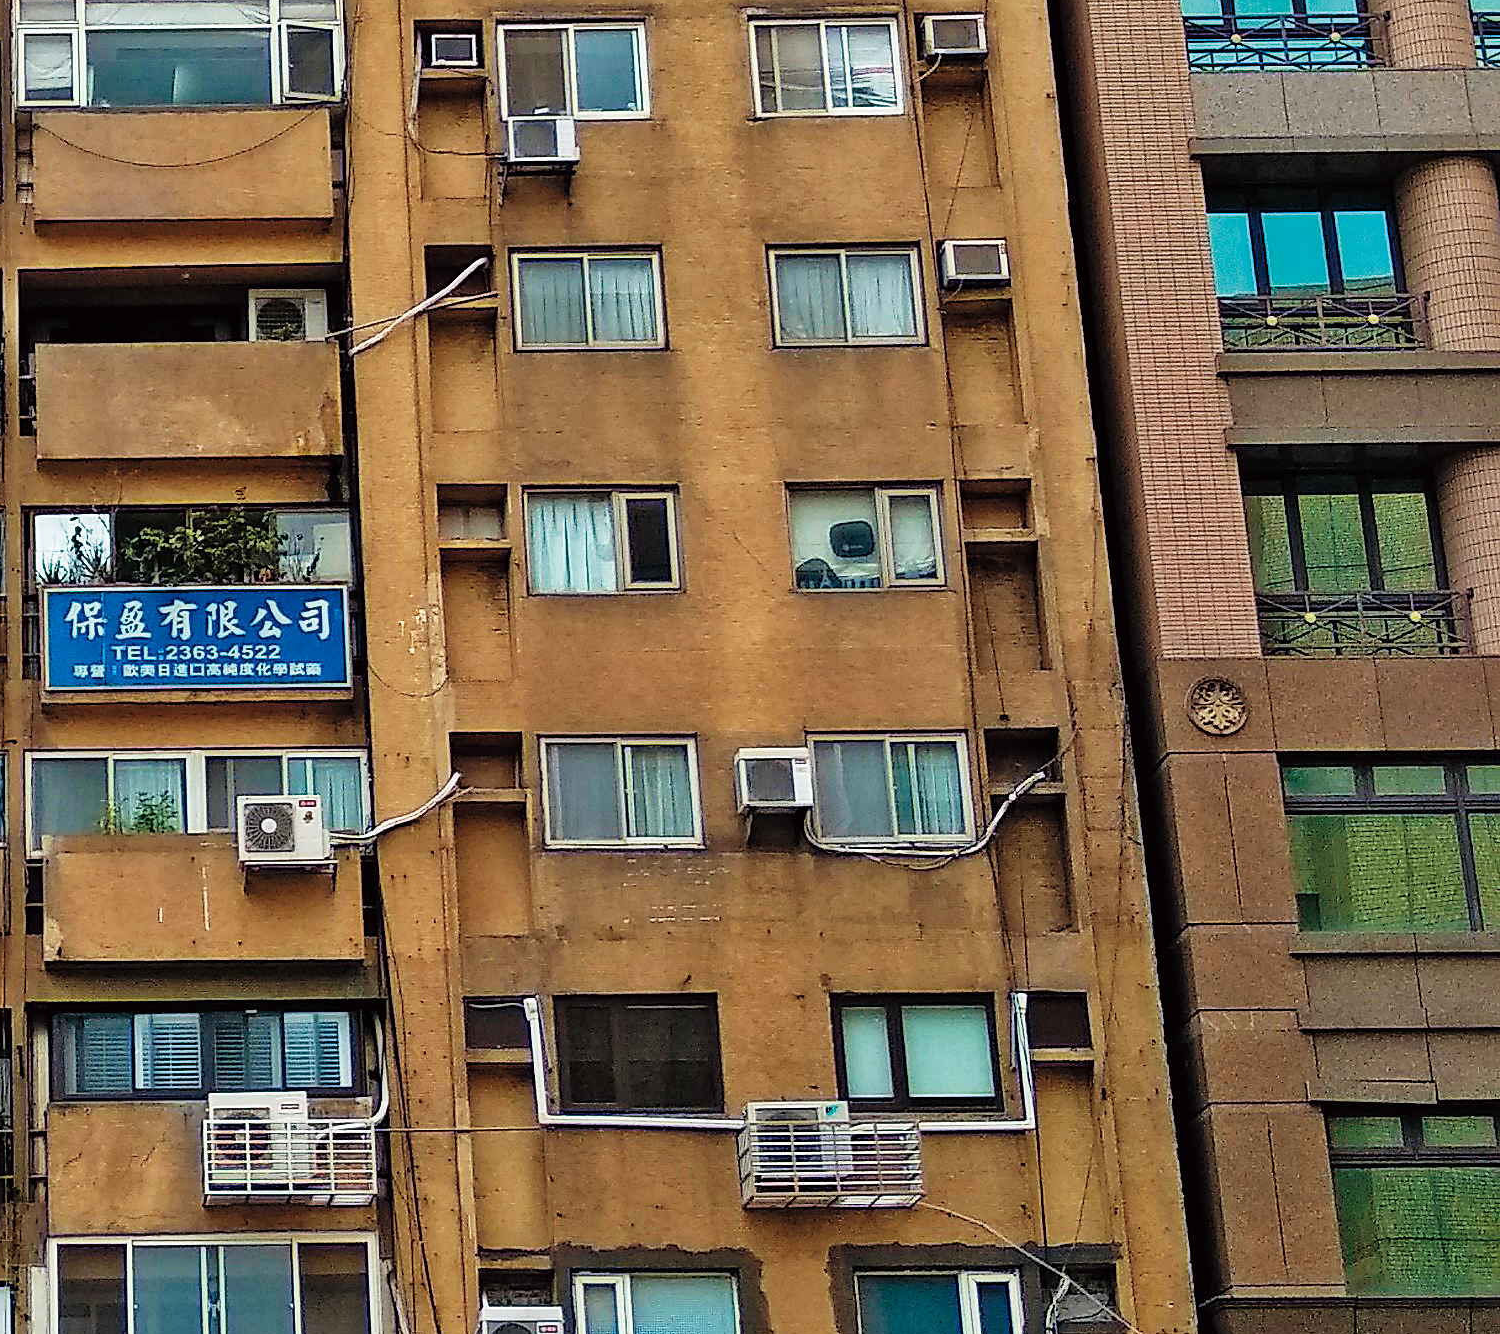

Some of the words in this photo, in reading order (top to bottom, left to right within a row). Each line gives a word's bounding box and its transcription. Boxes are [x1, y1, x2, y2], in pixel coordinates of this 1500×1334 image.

[64, 599, 330, 641] 保盈有限公司
